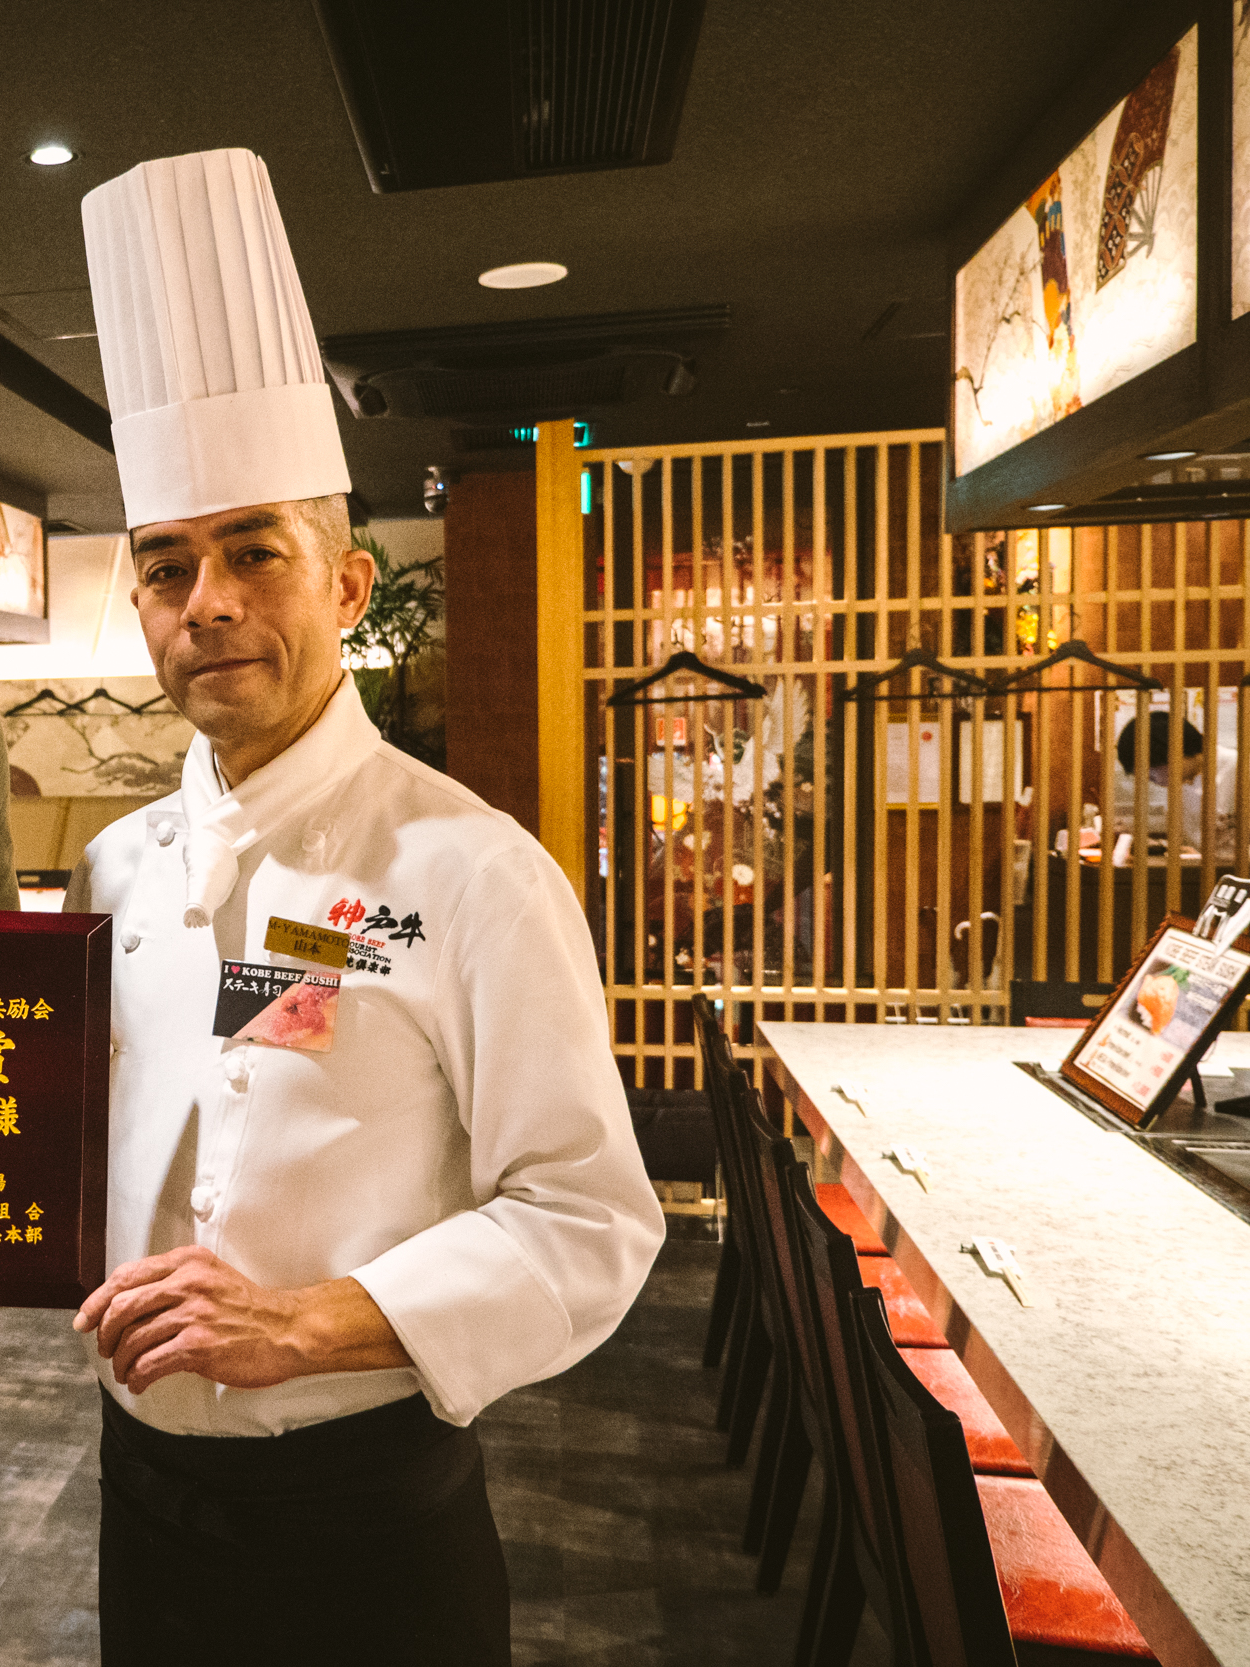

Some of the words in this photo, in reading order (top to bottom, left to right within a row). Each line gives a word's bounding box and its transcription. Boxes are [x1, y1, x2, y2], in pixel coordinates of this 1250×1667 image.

[293, 938, 322, 955] 山本
[349, 941, 378, 954] OURIST
[223, 964, 230, 974] I
[241, 966, 272, 979] KOBE
[273, 970, 303, 983] BEEF
[304, 974, 339, 988] SUSHI
[222, 978, 283, 998] ステーキ寿司
